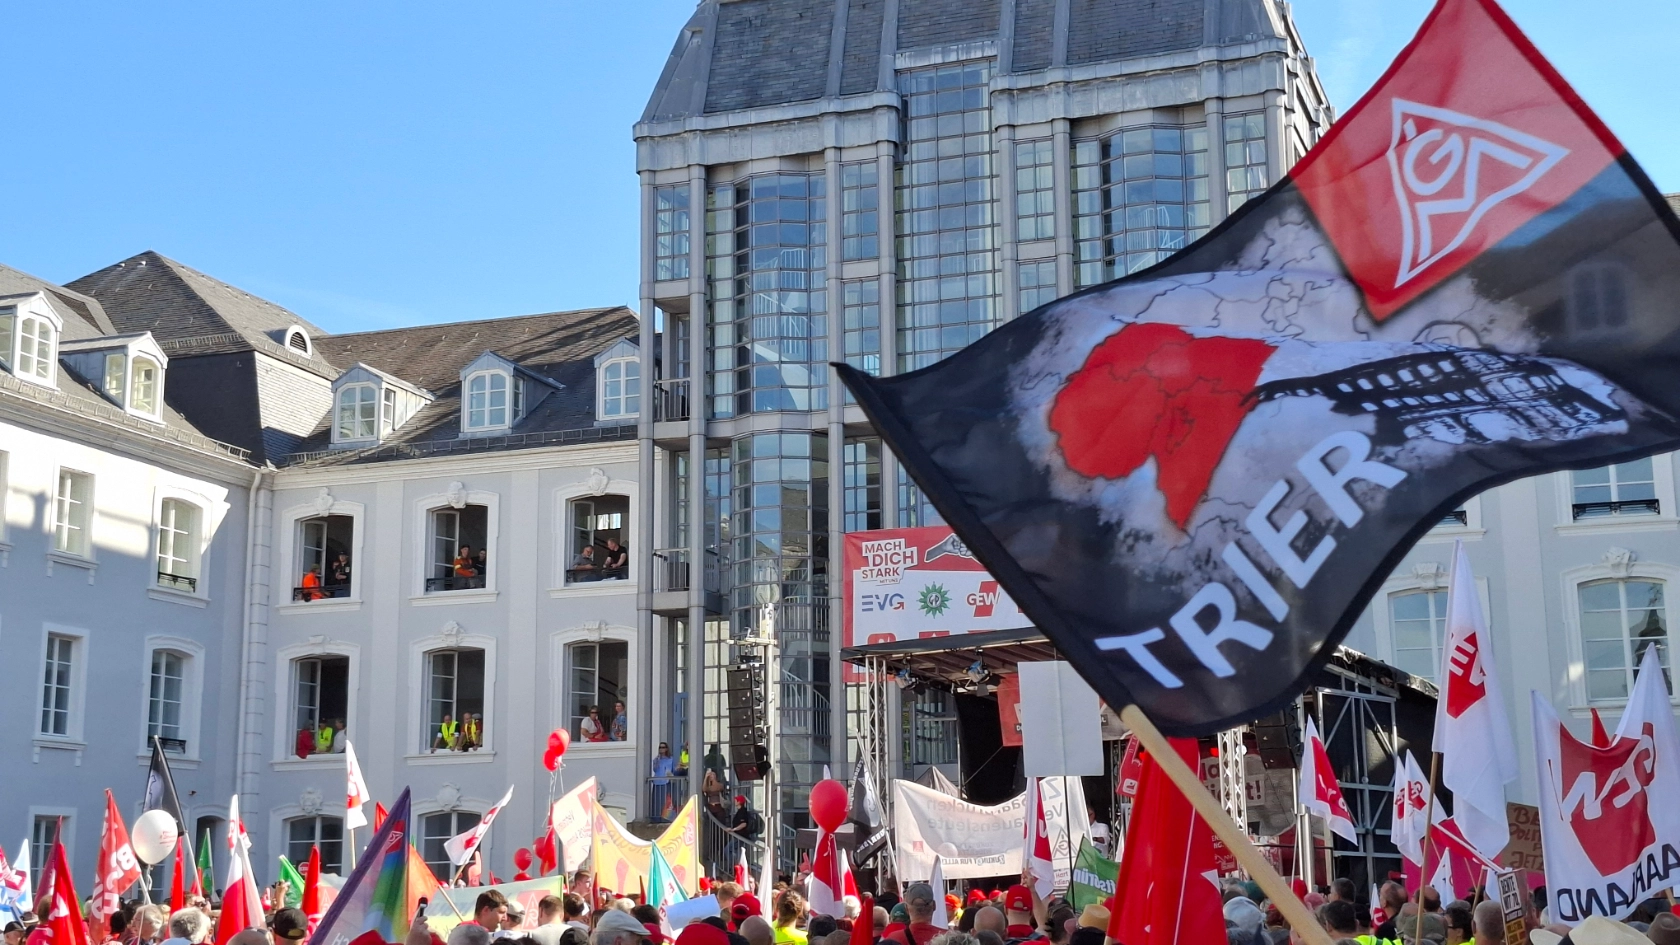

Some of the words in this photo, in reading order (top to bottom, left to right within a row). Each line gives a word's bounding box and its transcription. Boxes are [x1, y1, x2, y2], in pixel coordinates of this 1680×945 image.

[864, 541, 902, 554] MACH
[872, 551, 914, 567] DICH
[1094, 430, 1408, 690] TRIER
[861, 567, 900, 579] STARK
[861, 593, 905, 611] EVG
[966, 591, 1001, 606] GEW
[1513, 806, 1541, 825] BE
[1509, 851, 1544, 870] JETZ
